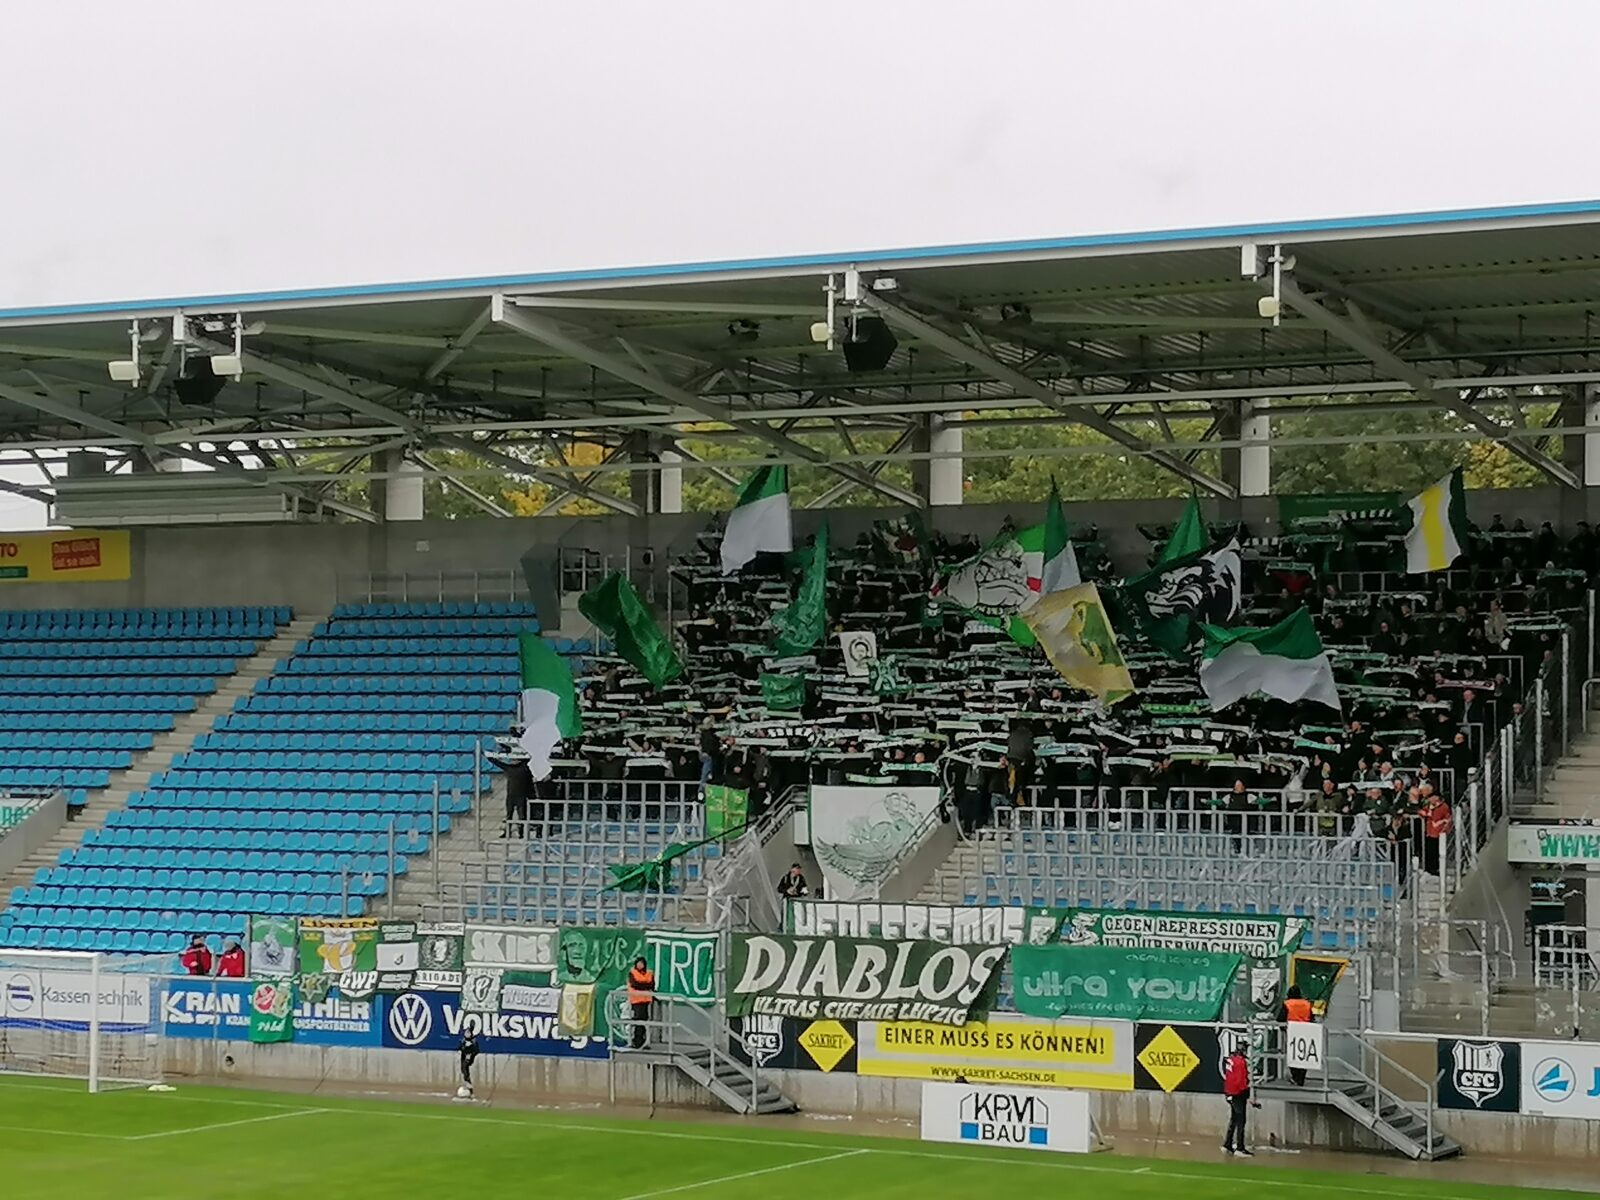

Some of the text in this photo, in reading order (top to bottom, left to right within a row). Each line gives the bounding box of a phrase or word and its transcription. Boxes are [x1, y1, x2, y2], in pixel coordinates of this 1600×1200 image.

[1105, 916, 1276, 938] GEGEN REPRESSIONEN
[647, 938, 714, 995] TRC
[733, 935, 1006, 1005] DIABLOS
[41, 986, 143, 1007] Kassenechnik
[753, 997, 819, 1017] ULTRAS
[824, 1000, 898, 1020] CHEMIE
[808, 1032, 844, 1049] SAKRET
[885, 1027, 1105, 1055] EINER MUSS ES KÖNNEN!
[1290, 1037, 1318, 1062] 19A
[1147, 1050, 1187, 1068] SAKRET
[1461, 1072, 1495, 1087] CFC
[974, 1092, 1034, 1124] KPM
[981, 1124, 1026, 1143] BAU
